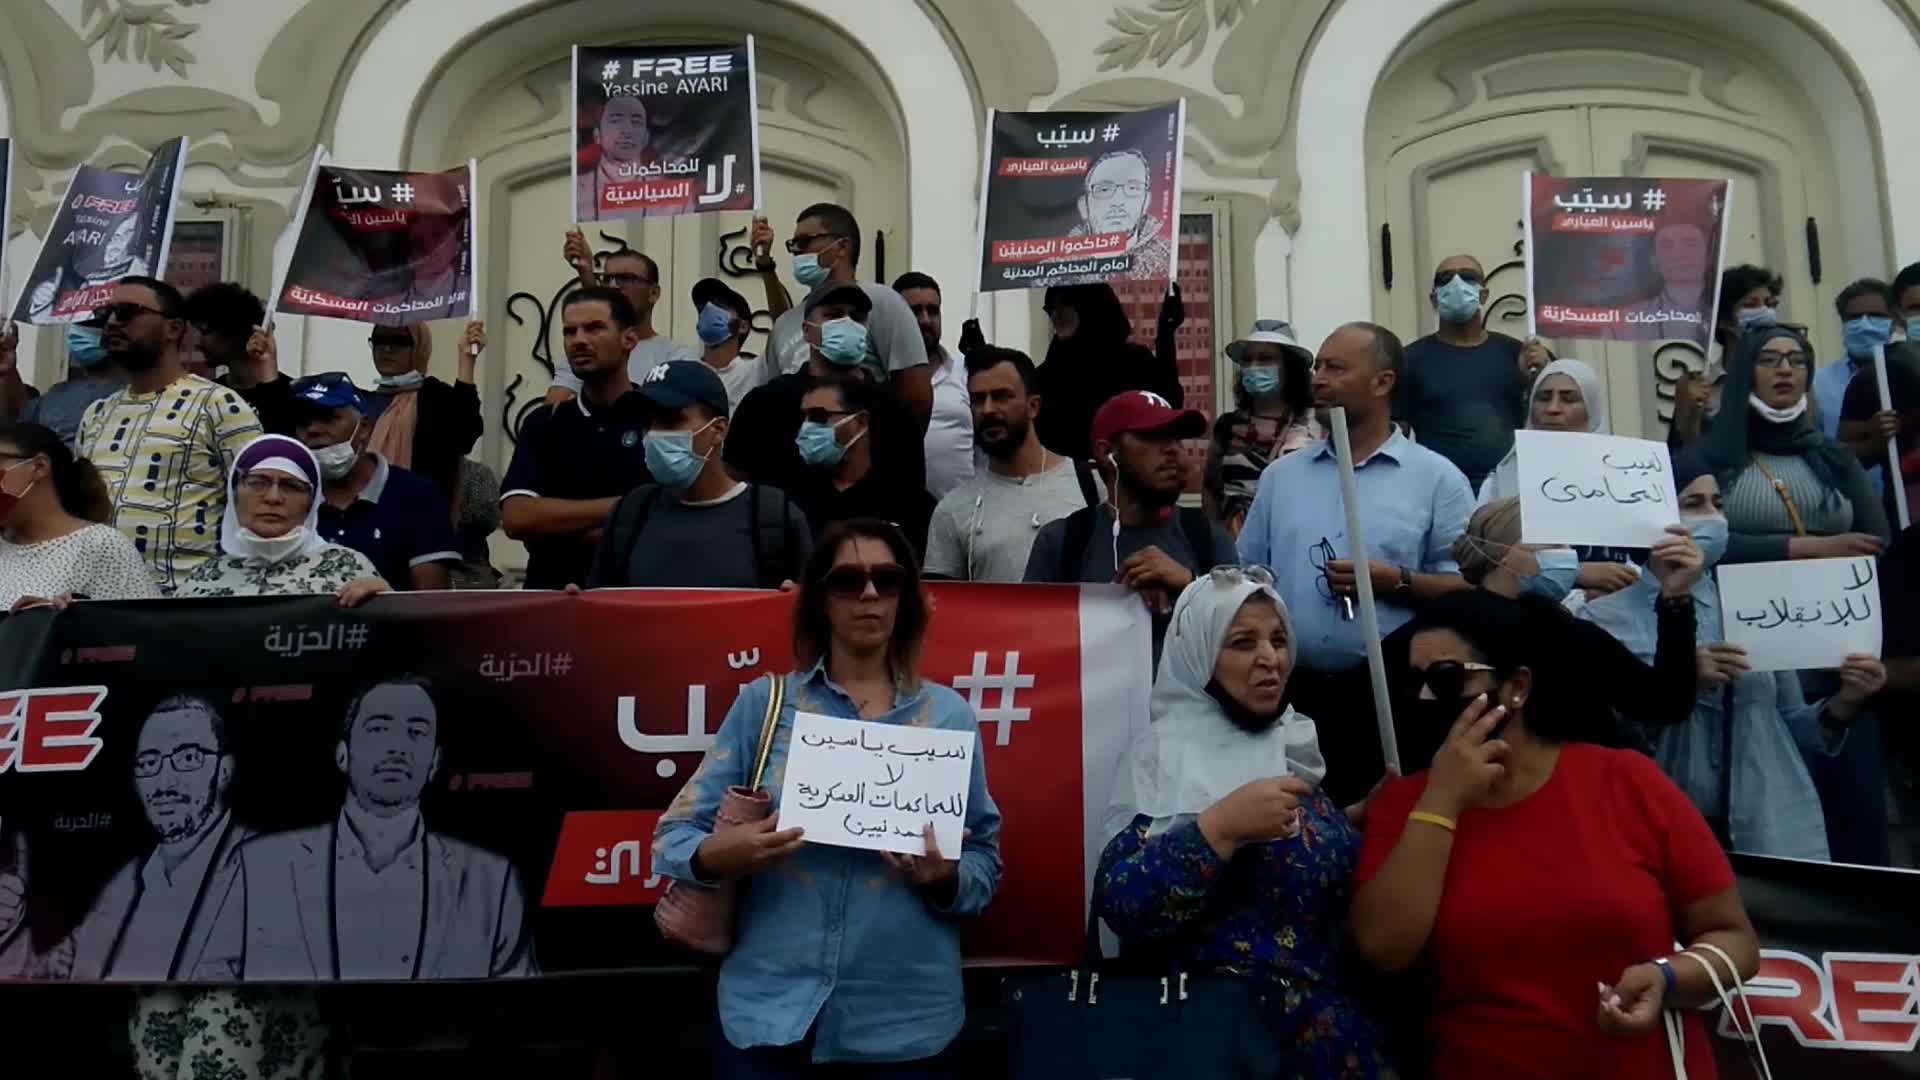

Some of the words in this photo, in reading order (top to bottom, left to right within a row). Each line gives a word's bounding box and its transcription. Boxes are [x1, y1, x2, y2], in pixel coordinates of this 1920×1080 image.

[632, 54, 734, 78] FREE
[602, 78, 668, 97] Yassine
[676, 76, 729, 94] AYARI
[618, 157, 700, 178] للمحاكمات
[1050, 159, 1088, 172] ياسين
[1611, 216, 1655, 230] ياسين
[373, 295, 444, 314] للمحاكمات
[1843, 558, 1874, 591] لا
[800, 728, 884, 758] ياسين
[875, 763, 905, 786] لا
[798, 782, 867, 809] العسكرية
